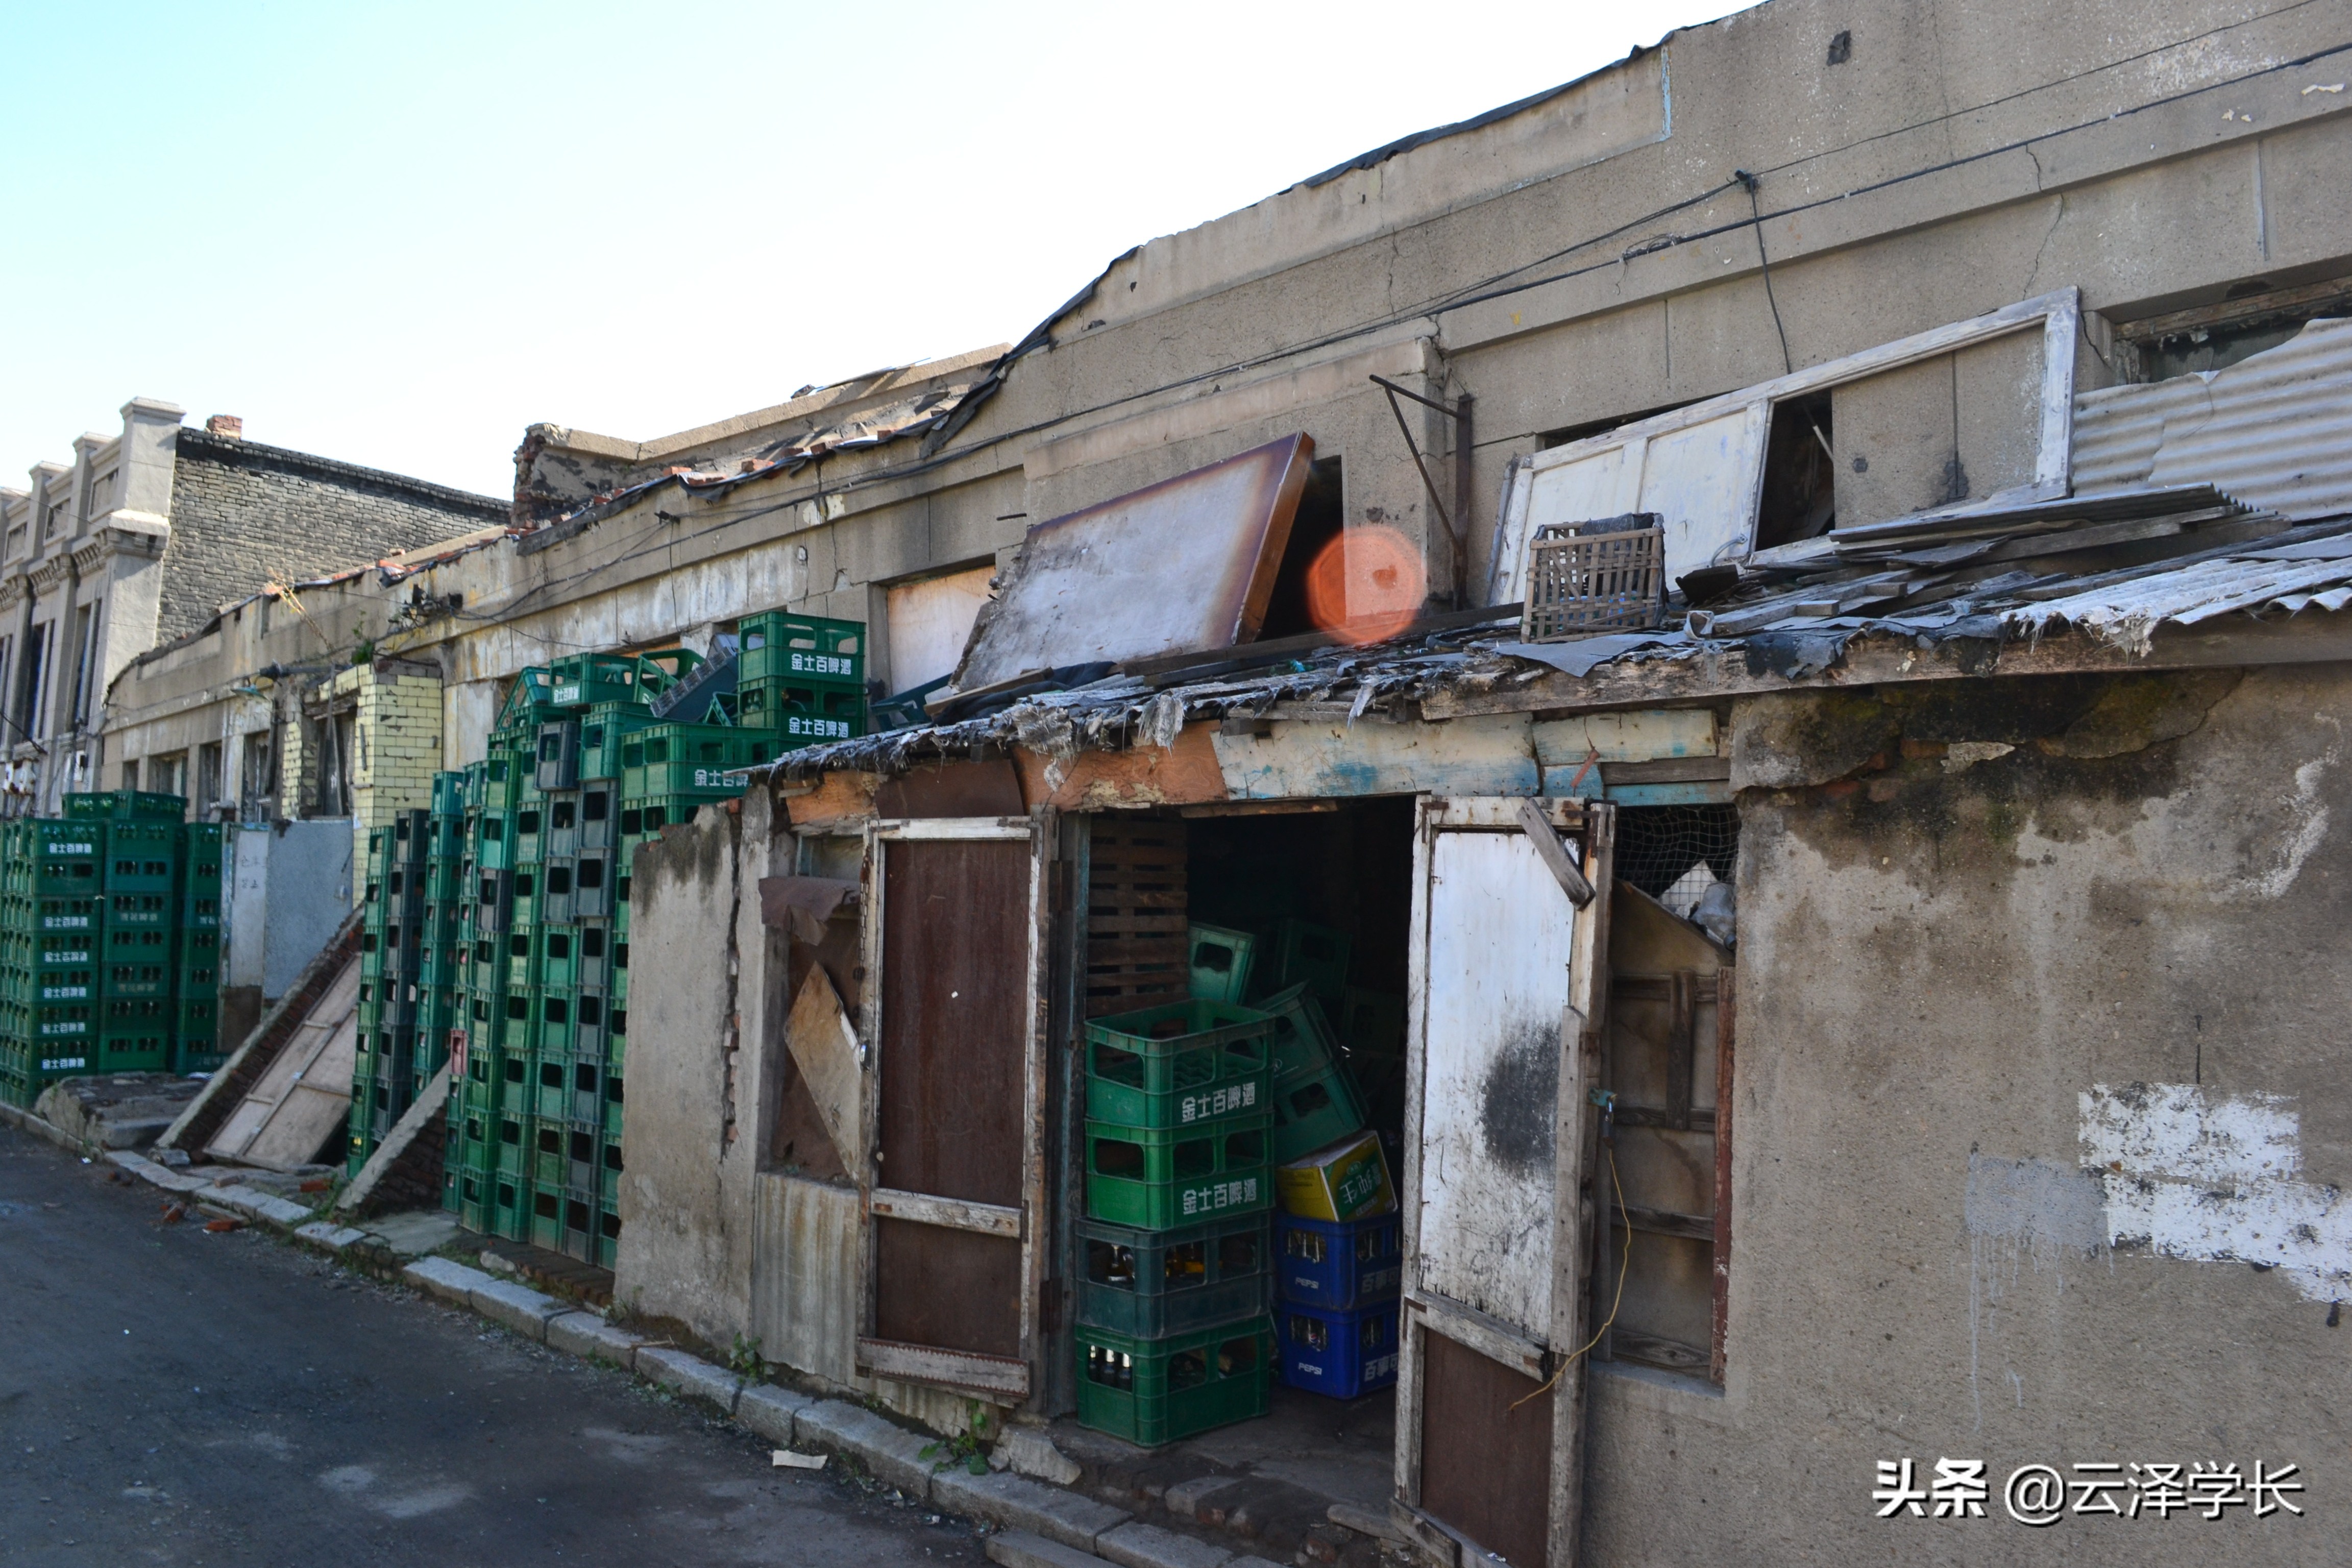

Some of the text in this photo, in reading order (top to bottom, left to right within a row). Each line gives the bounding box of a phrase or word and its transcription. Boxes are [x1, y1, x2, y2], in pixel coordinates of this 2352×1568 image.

[791, 653, 851, 675] 金士百啤酒
[789, 717, 849, 738] 金士百啤酒
[695, 769, 752, 787] 金士百啤
[1182, 1082, 1256, 1122] 金士百啤酒
[1183, 1178, 1257, 1215] 金士百啤酒
[1295, 1277, 1319, 1290] PEPSI
[1298, 1362, 1322, 1376] PEPSI
